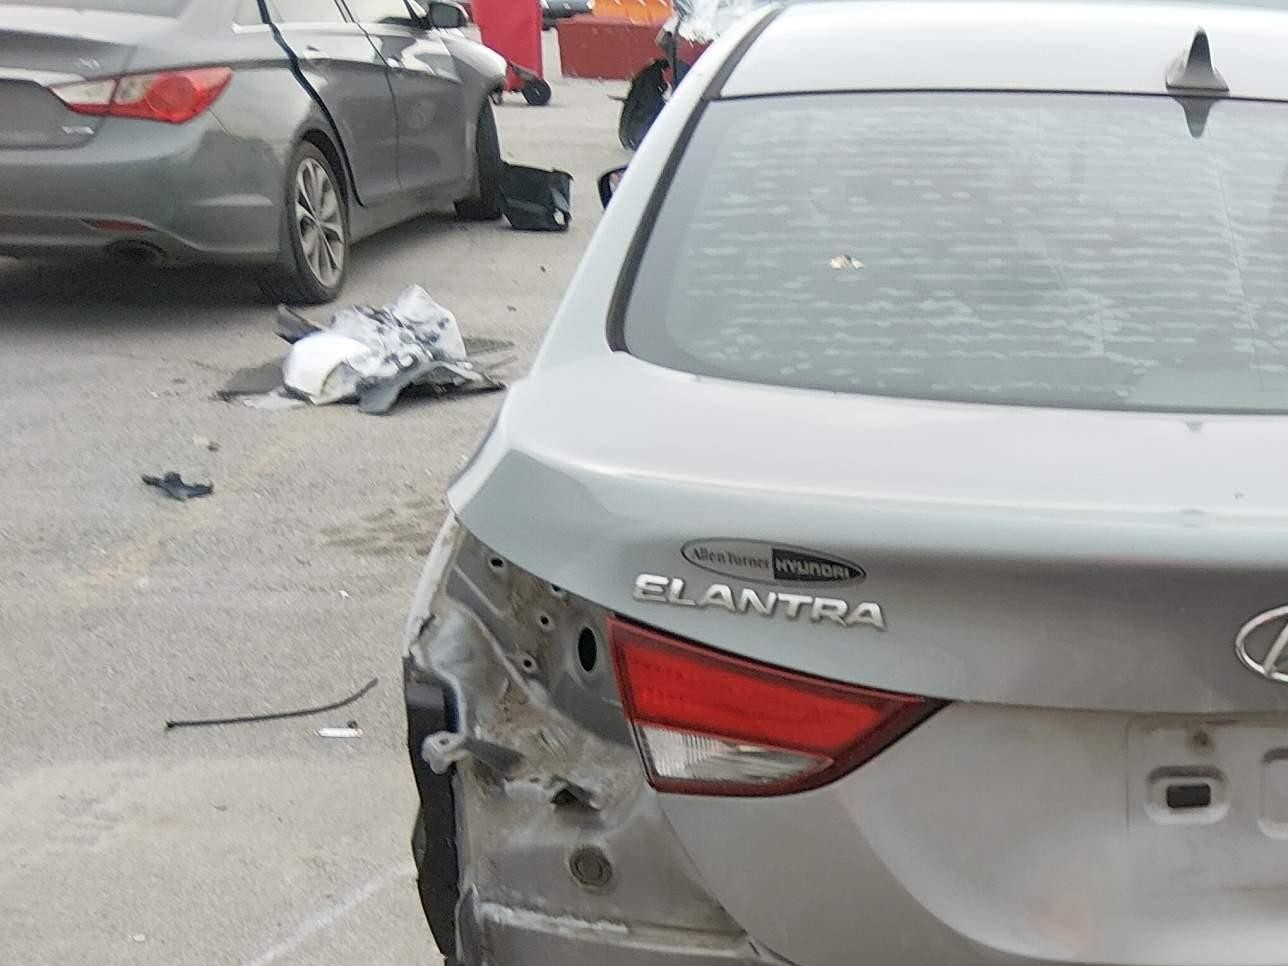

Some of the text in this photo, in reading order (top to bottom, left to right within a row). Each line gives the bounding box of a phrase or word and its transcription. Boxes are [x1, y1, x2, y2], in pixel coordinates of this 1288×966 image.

[692, 546, 725, 564] Allen
[724, 550, 770, 570] Turner
[633, 573, 888, 632] ELANTRA
